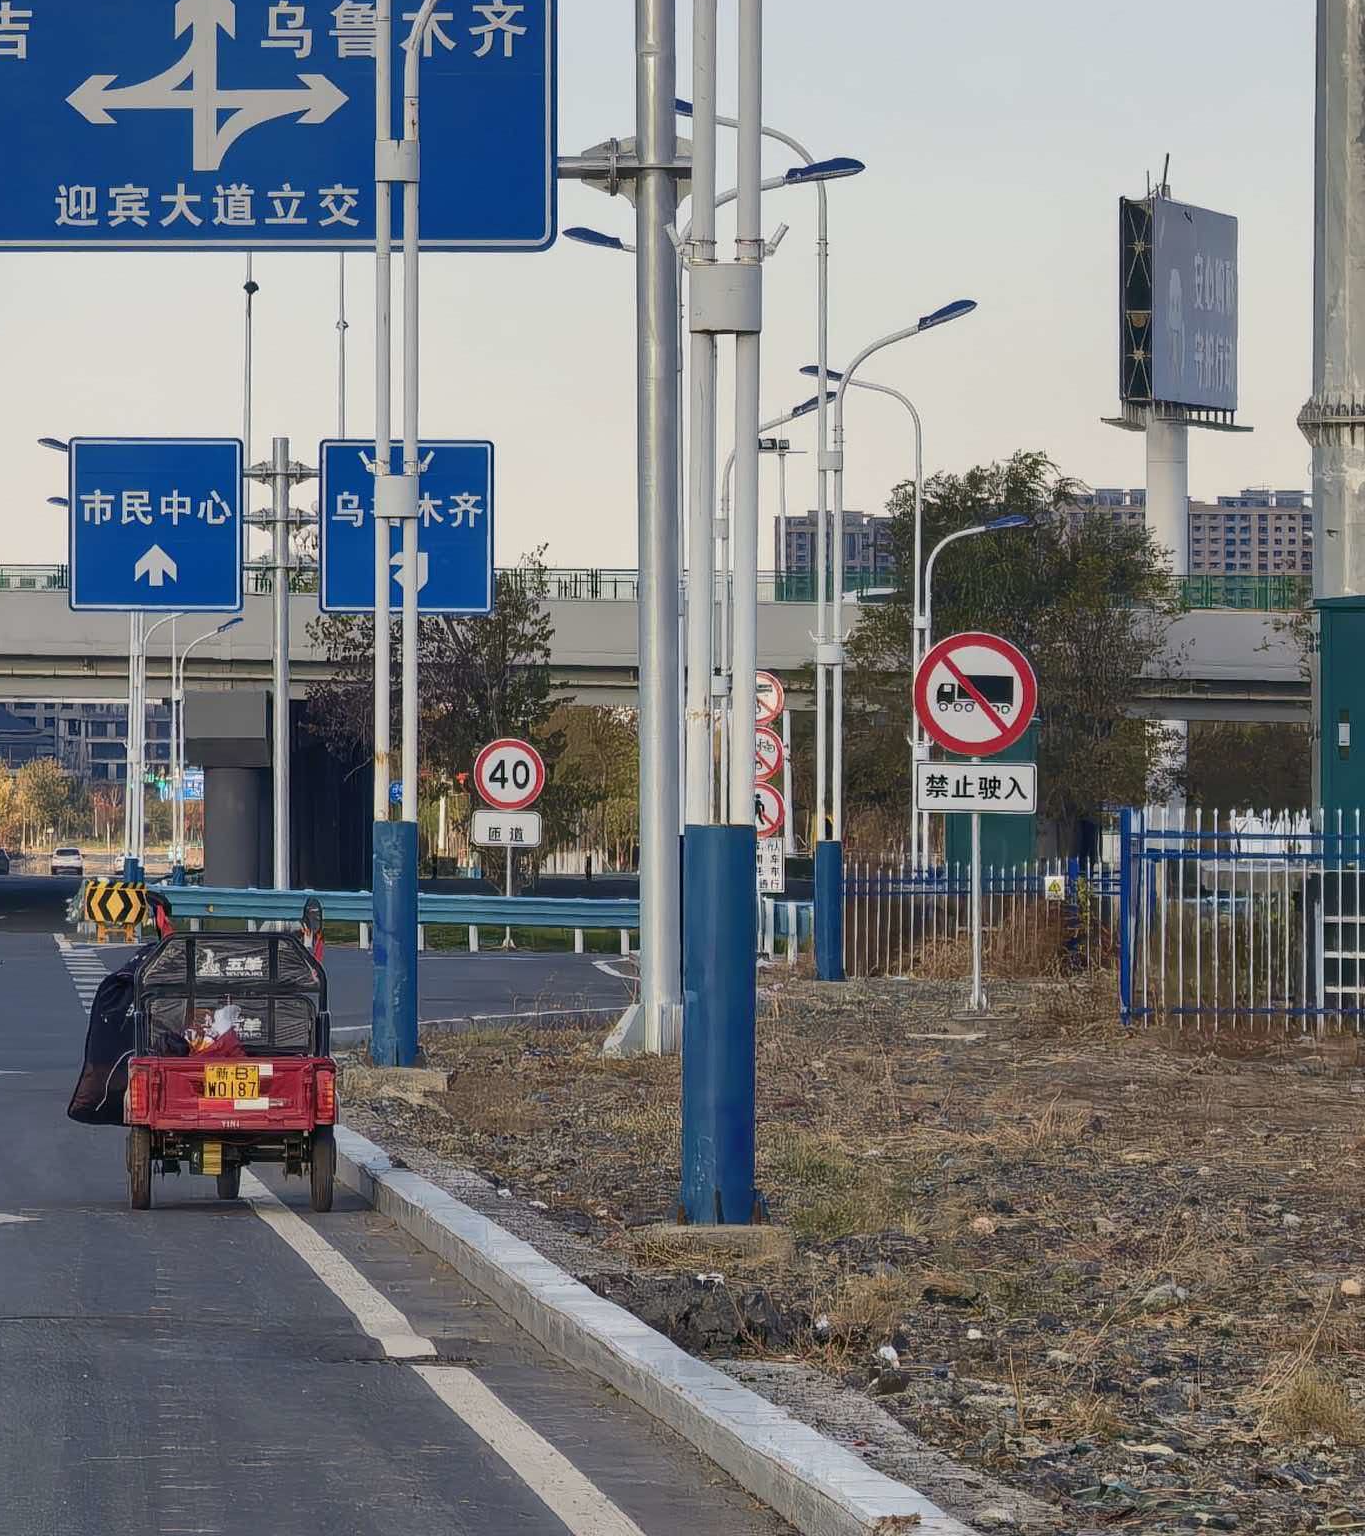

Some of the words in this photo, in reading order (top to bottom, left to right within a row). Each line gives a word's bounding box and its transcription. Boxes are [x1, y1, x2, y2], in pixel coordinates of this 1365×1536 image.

[55, 183, 360, 227] 迎宾大道立交
[79, 489, 232, 527] 市民中心
[332, 491, 484, 528] 乌木齐
[488, 759, 530, 790] 40
[925, 774, 1029, 801] 禁止驶入
